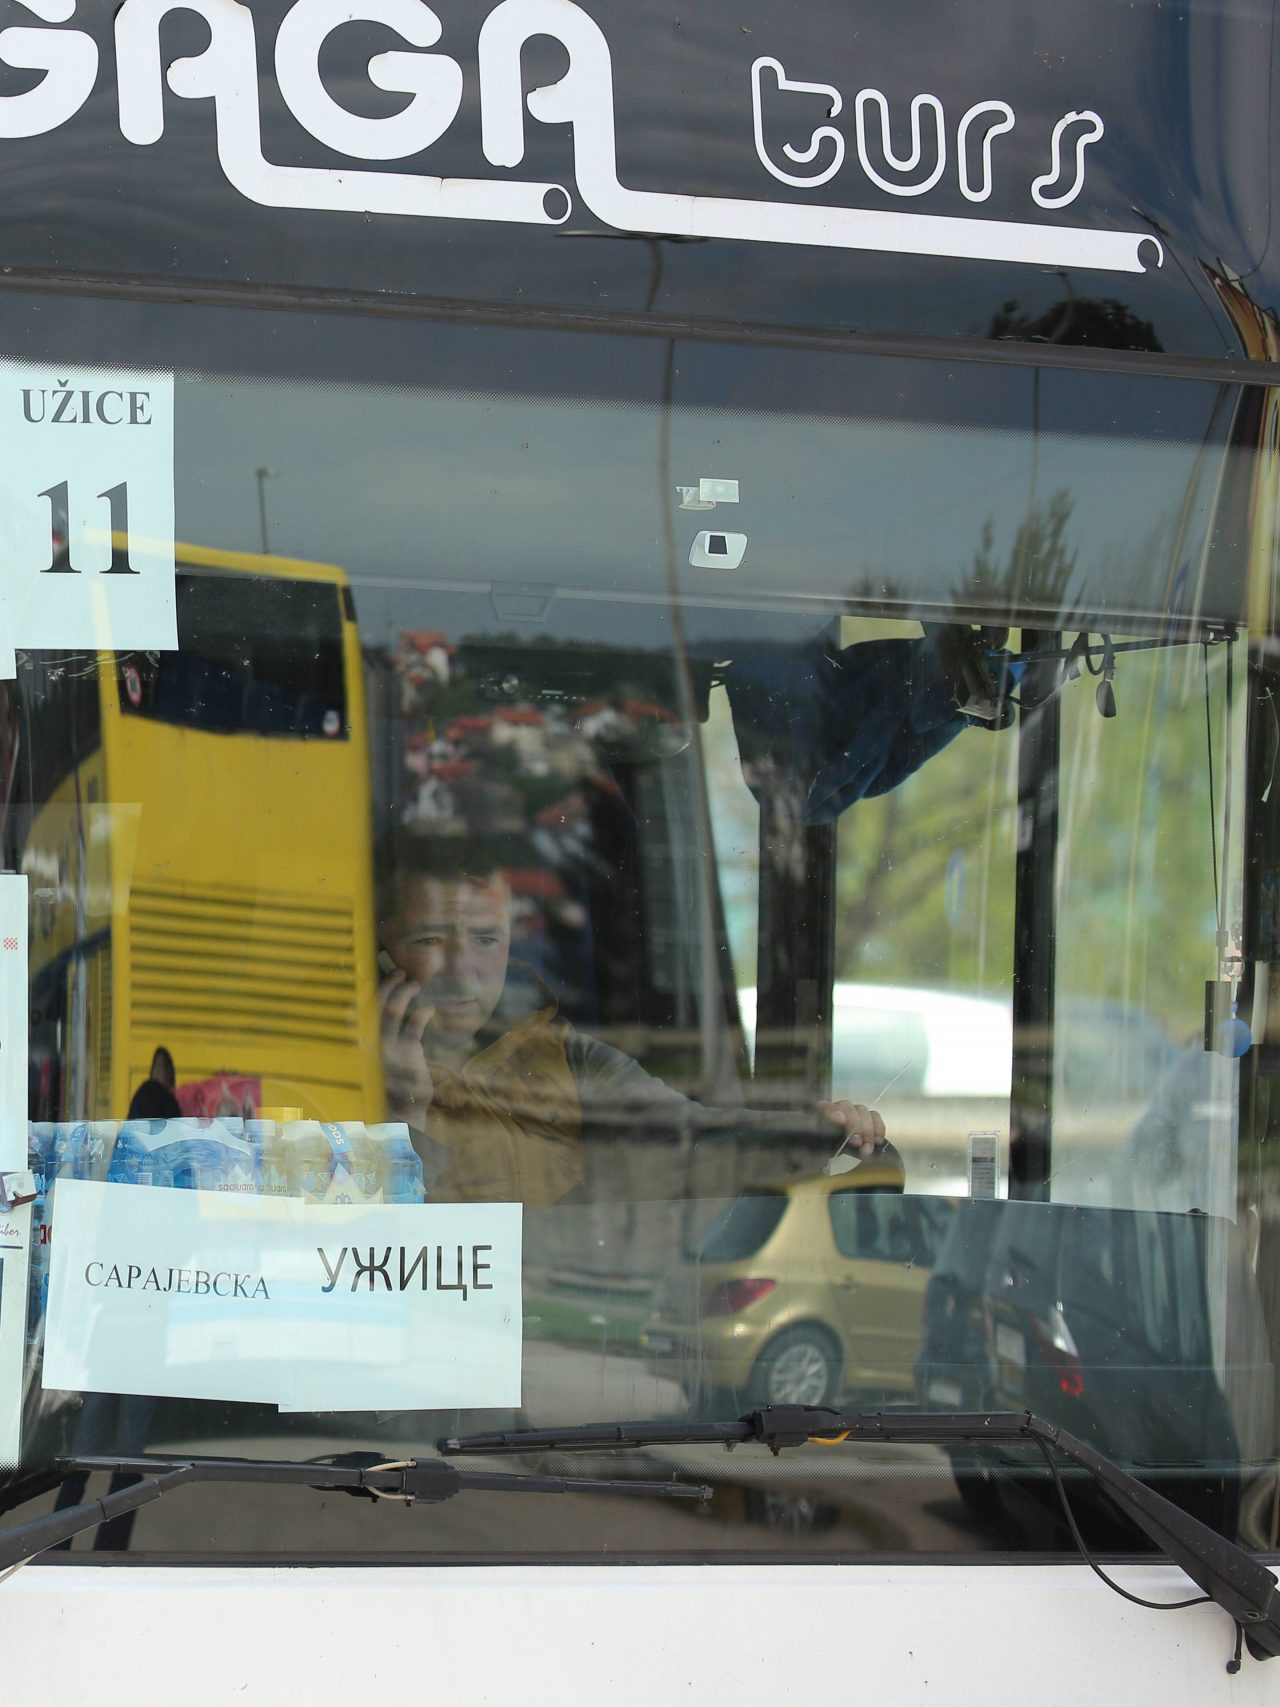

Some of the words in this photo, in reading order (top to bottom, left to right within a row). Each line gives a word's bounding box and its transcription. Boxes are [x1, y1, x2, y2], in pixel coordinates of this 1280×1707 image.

[751, 56, 1105, 210] turs
[20, 379, 153, 425] UŽICE
[37, 480, 141, 575] 11
[84, 1261, 271, 1300] САРАЈЕВСКА
[317, 1244, 493, 1301] УЖИЦЕ
